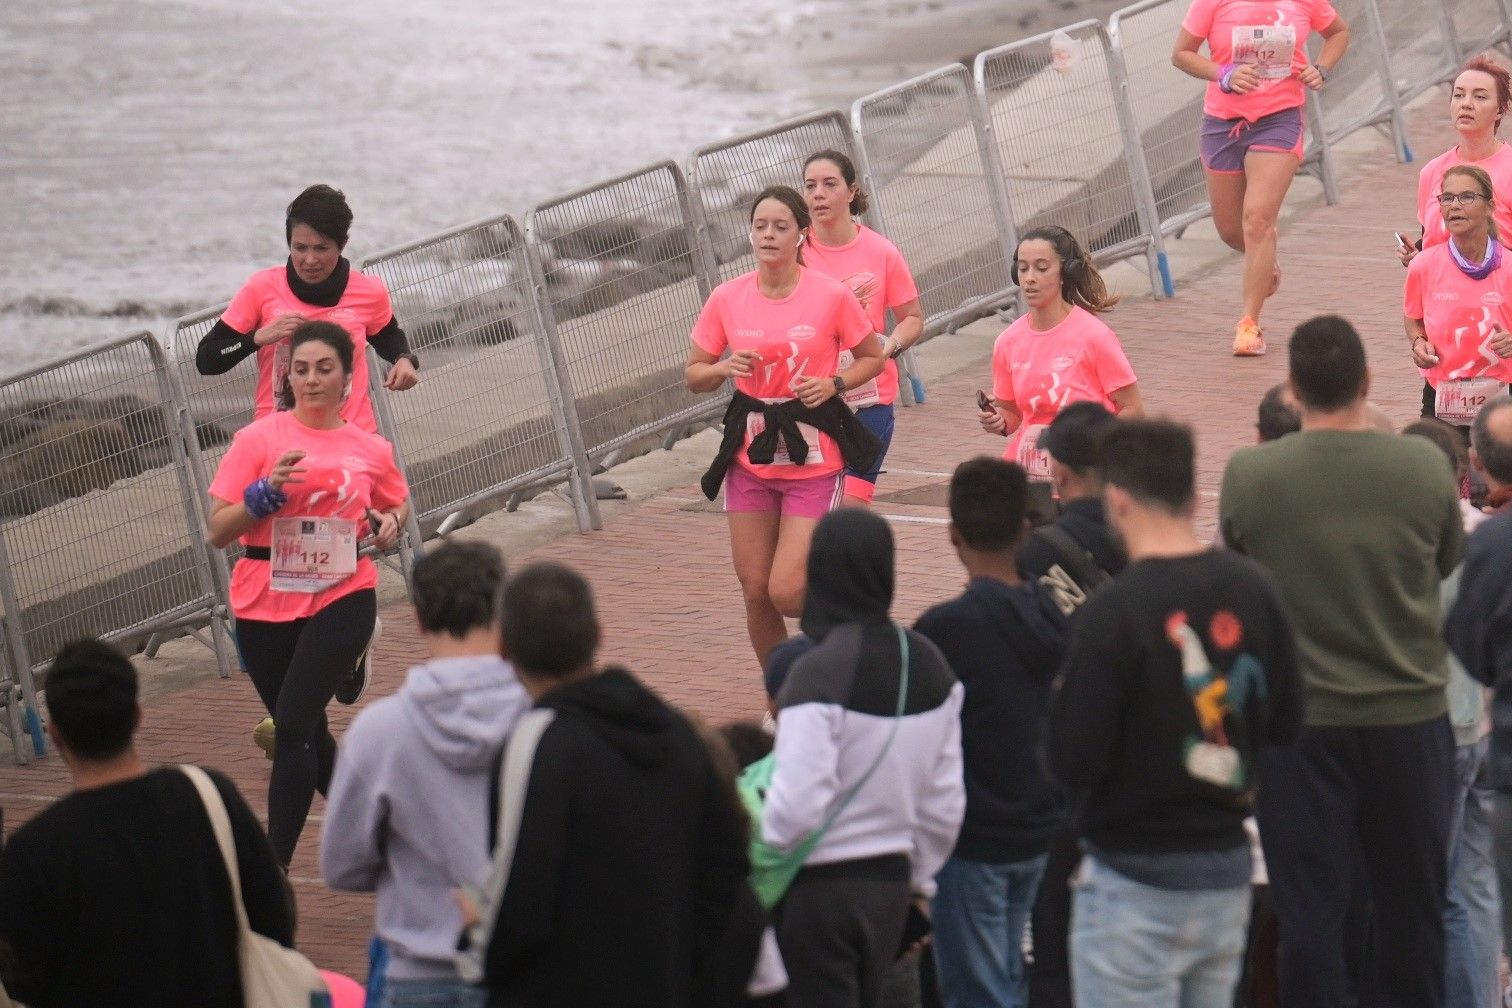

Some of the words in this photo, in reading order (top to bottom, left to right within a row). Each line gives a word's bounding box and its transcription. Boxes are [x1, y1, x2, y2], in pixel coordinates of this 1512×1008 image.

[1255, 50, 1276, 60] 112
[1461, 395, 1486, 407] 112
[299, 552, 330, 565] 112
